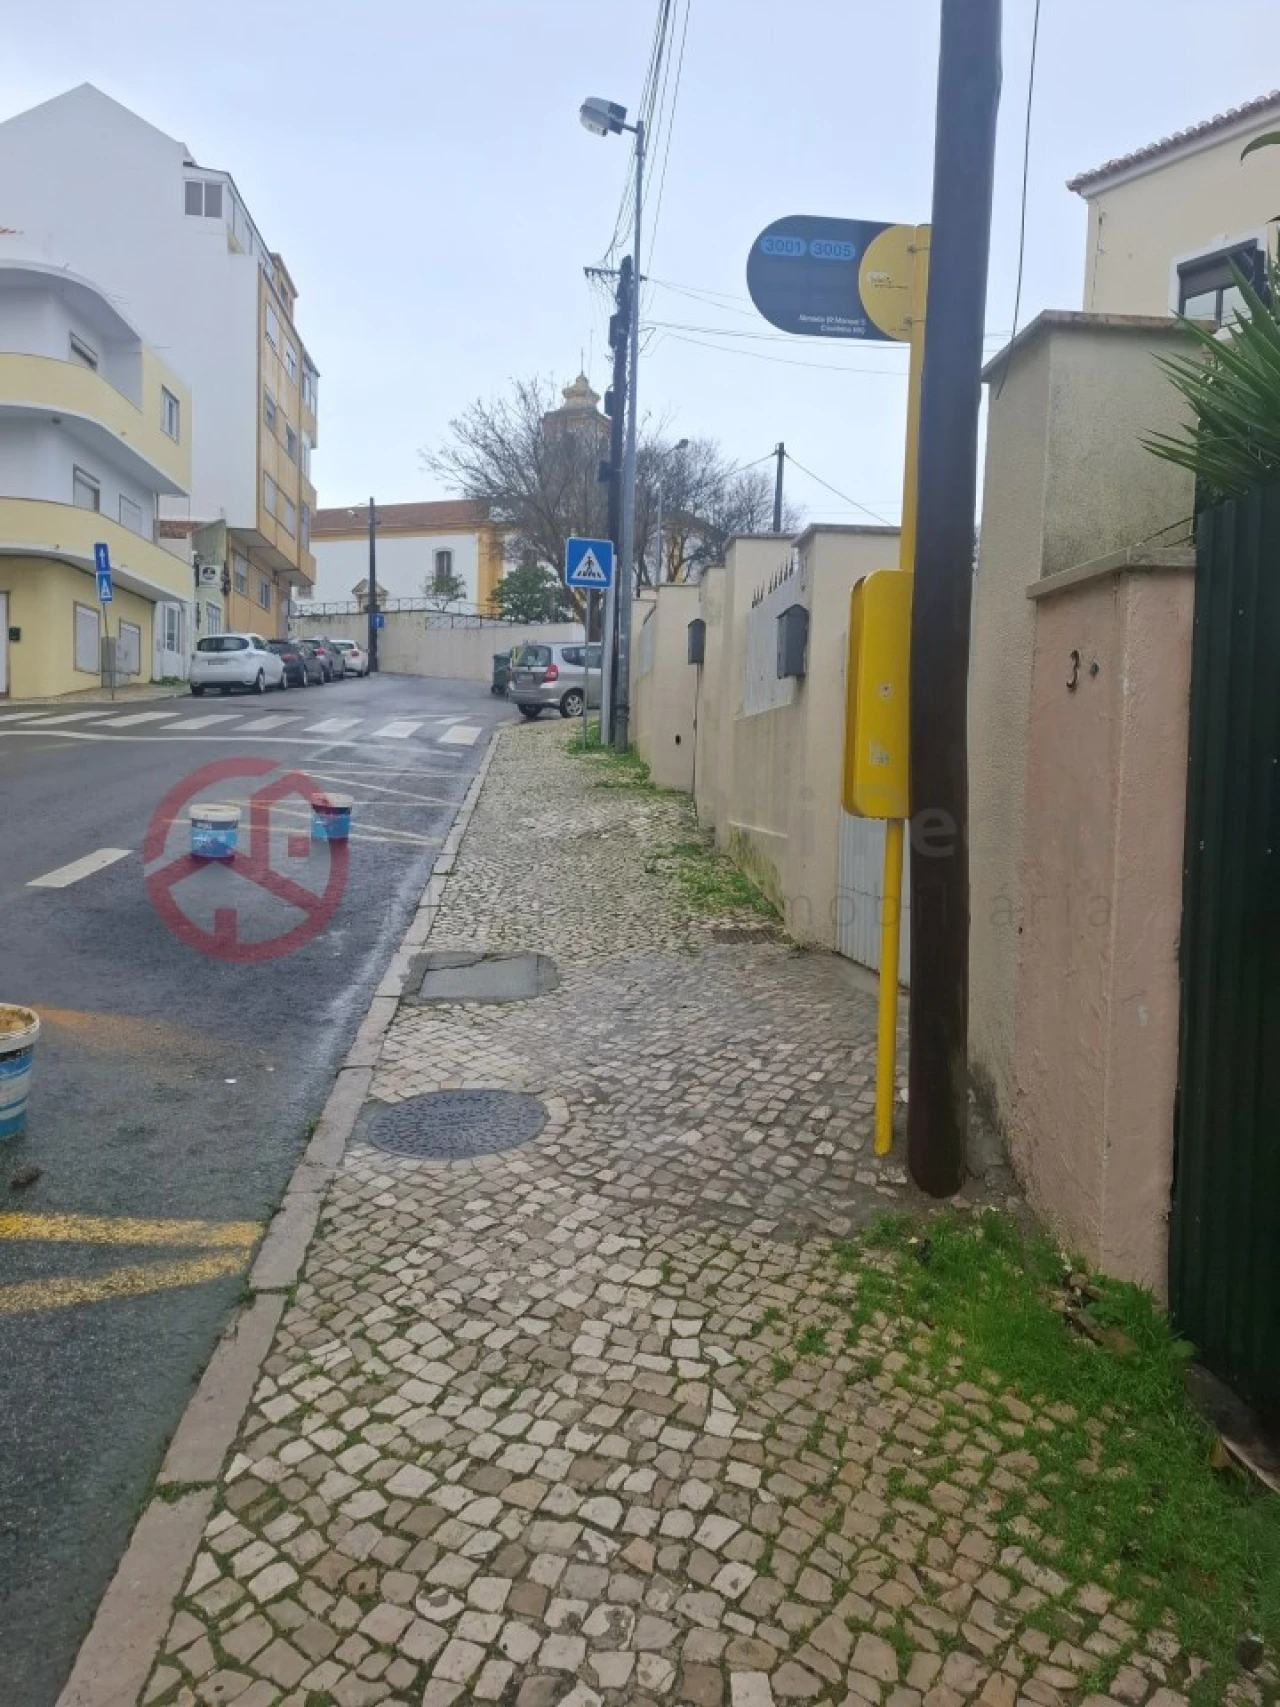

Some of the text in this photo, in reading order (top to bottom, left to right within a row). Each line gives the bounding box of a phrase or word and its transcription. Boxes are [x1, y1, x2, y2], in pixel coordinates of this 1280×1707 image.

[765, 238, 851, 257] 3001 3005
[1066, 650, 1080, 691] 3
